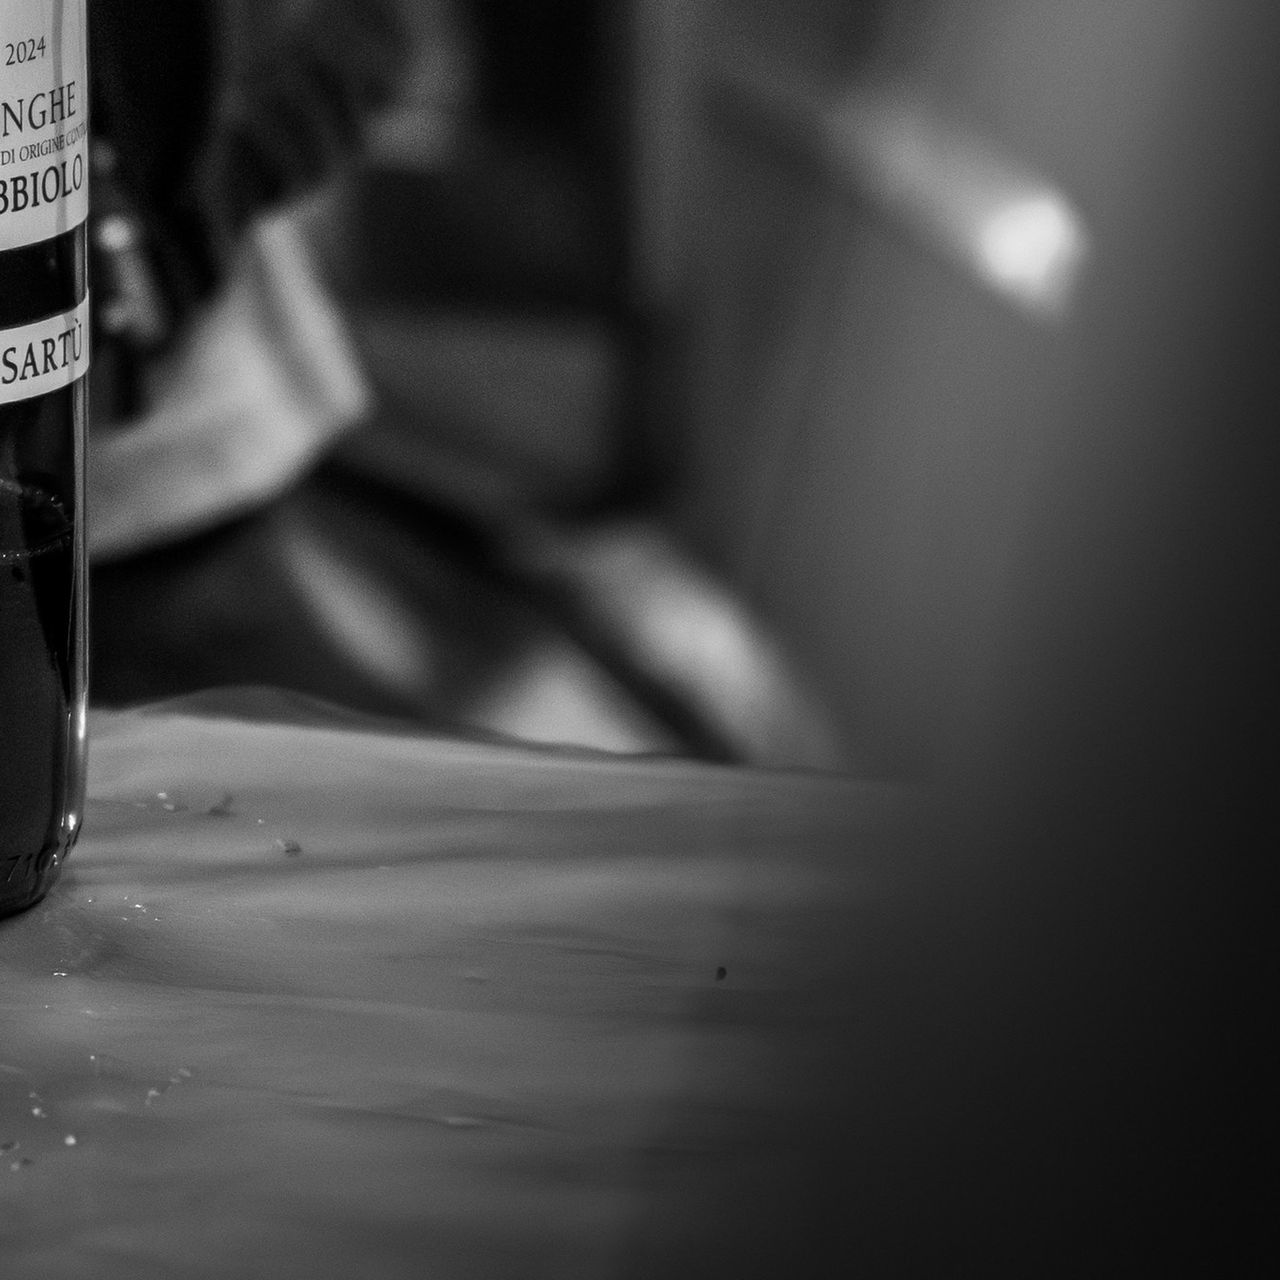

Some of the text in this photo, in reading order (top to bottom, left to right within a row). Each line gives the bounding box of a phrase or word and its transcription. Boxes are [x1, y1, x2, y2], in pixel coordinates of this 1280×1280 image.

[5, 35, 47, 66] 2024
[0, 148, 16, 165] DI
[18, 134, 65, 163] ORIGINE
[1, 318, 82, 385] SARTÙ
